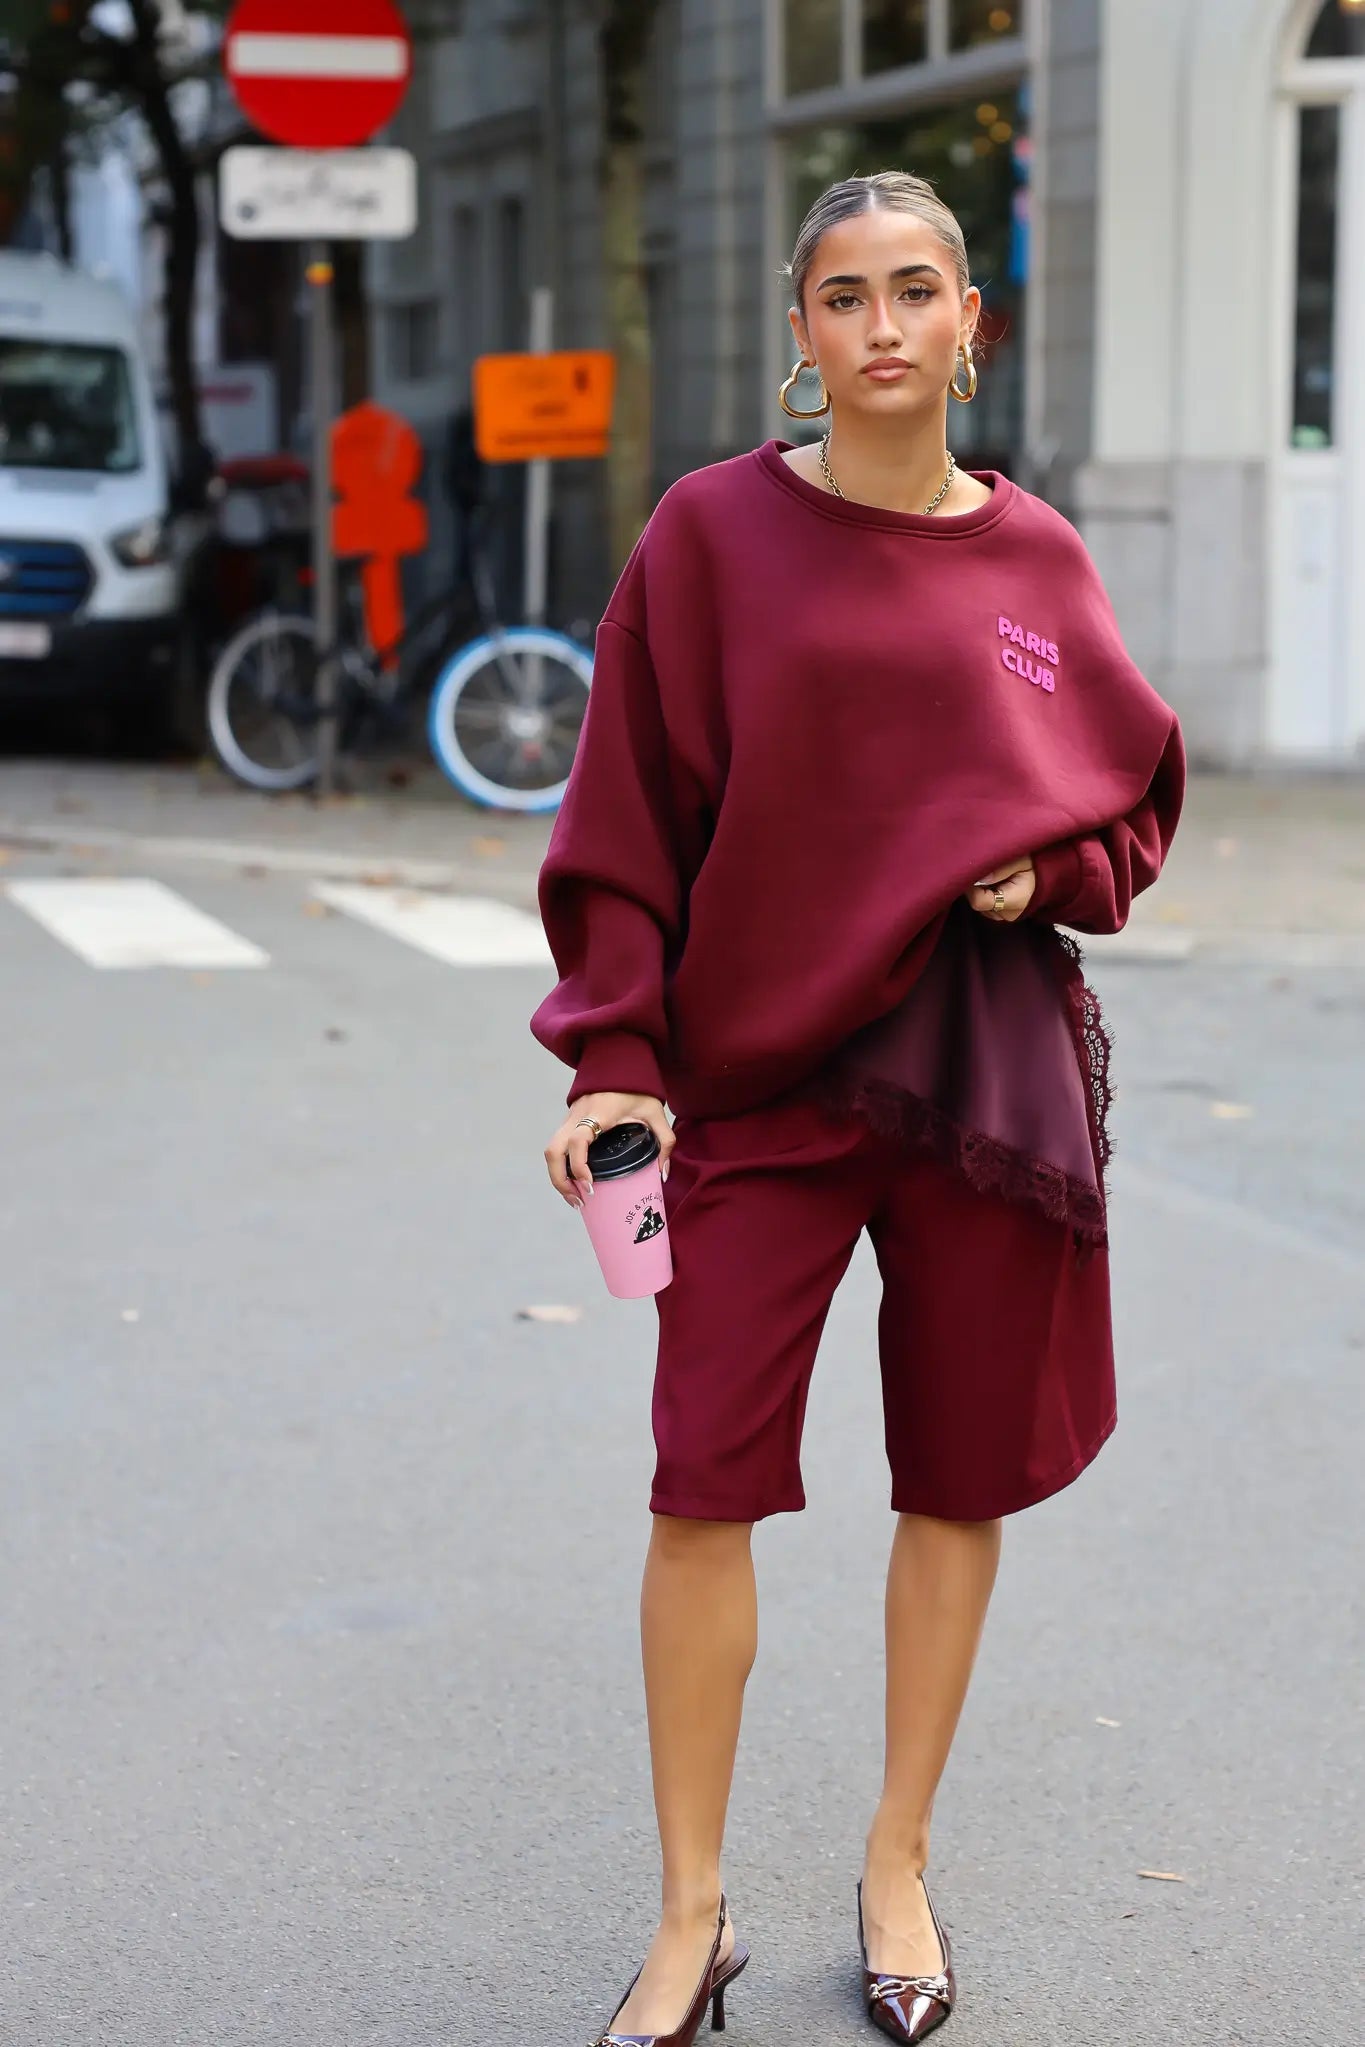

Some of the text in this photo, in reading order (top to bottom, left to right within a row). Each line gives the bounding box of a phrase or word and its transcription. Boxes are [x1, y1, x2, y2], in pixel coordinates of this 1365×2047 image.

[998, 616, 1060, 666] PARIS
[1001, 648, 1056, 693] CLUB
[625, 1210, 636, 1225] JOE
[641, 1193, 653, 1205] THE
